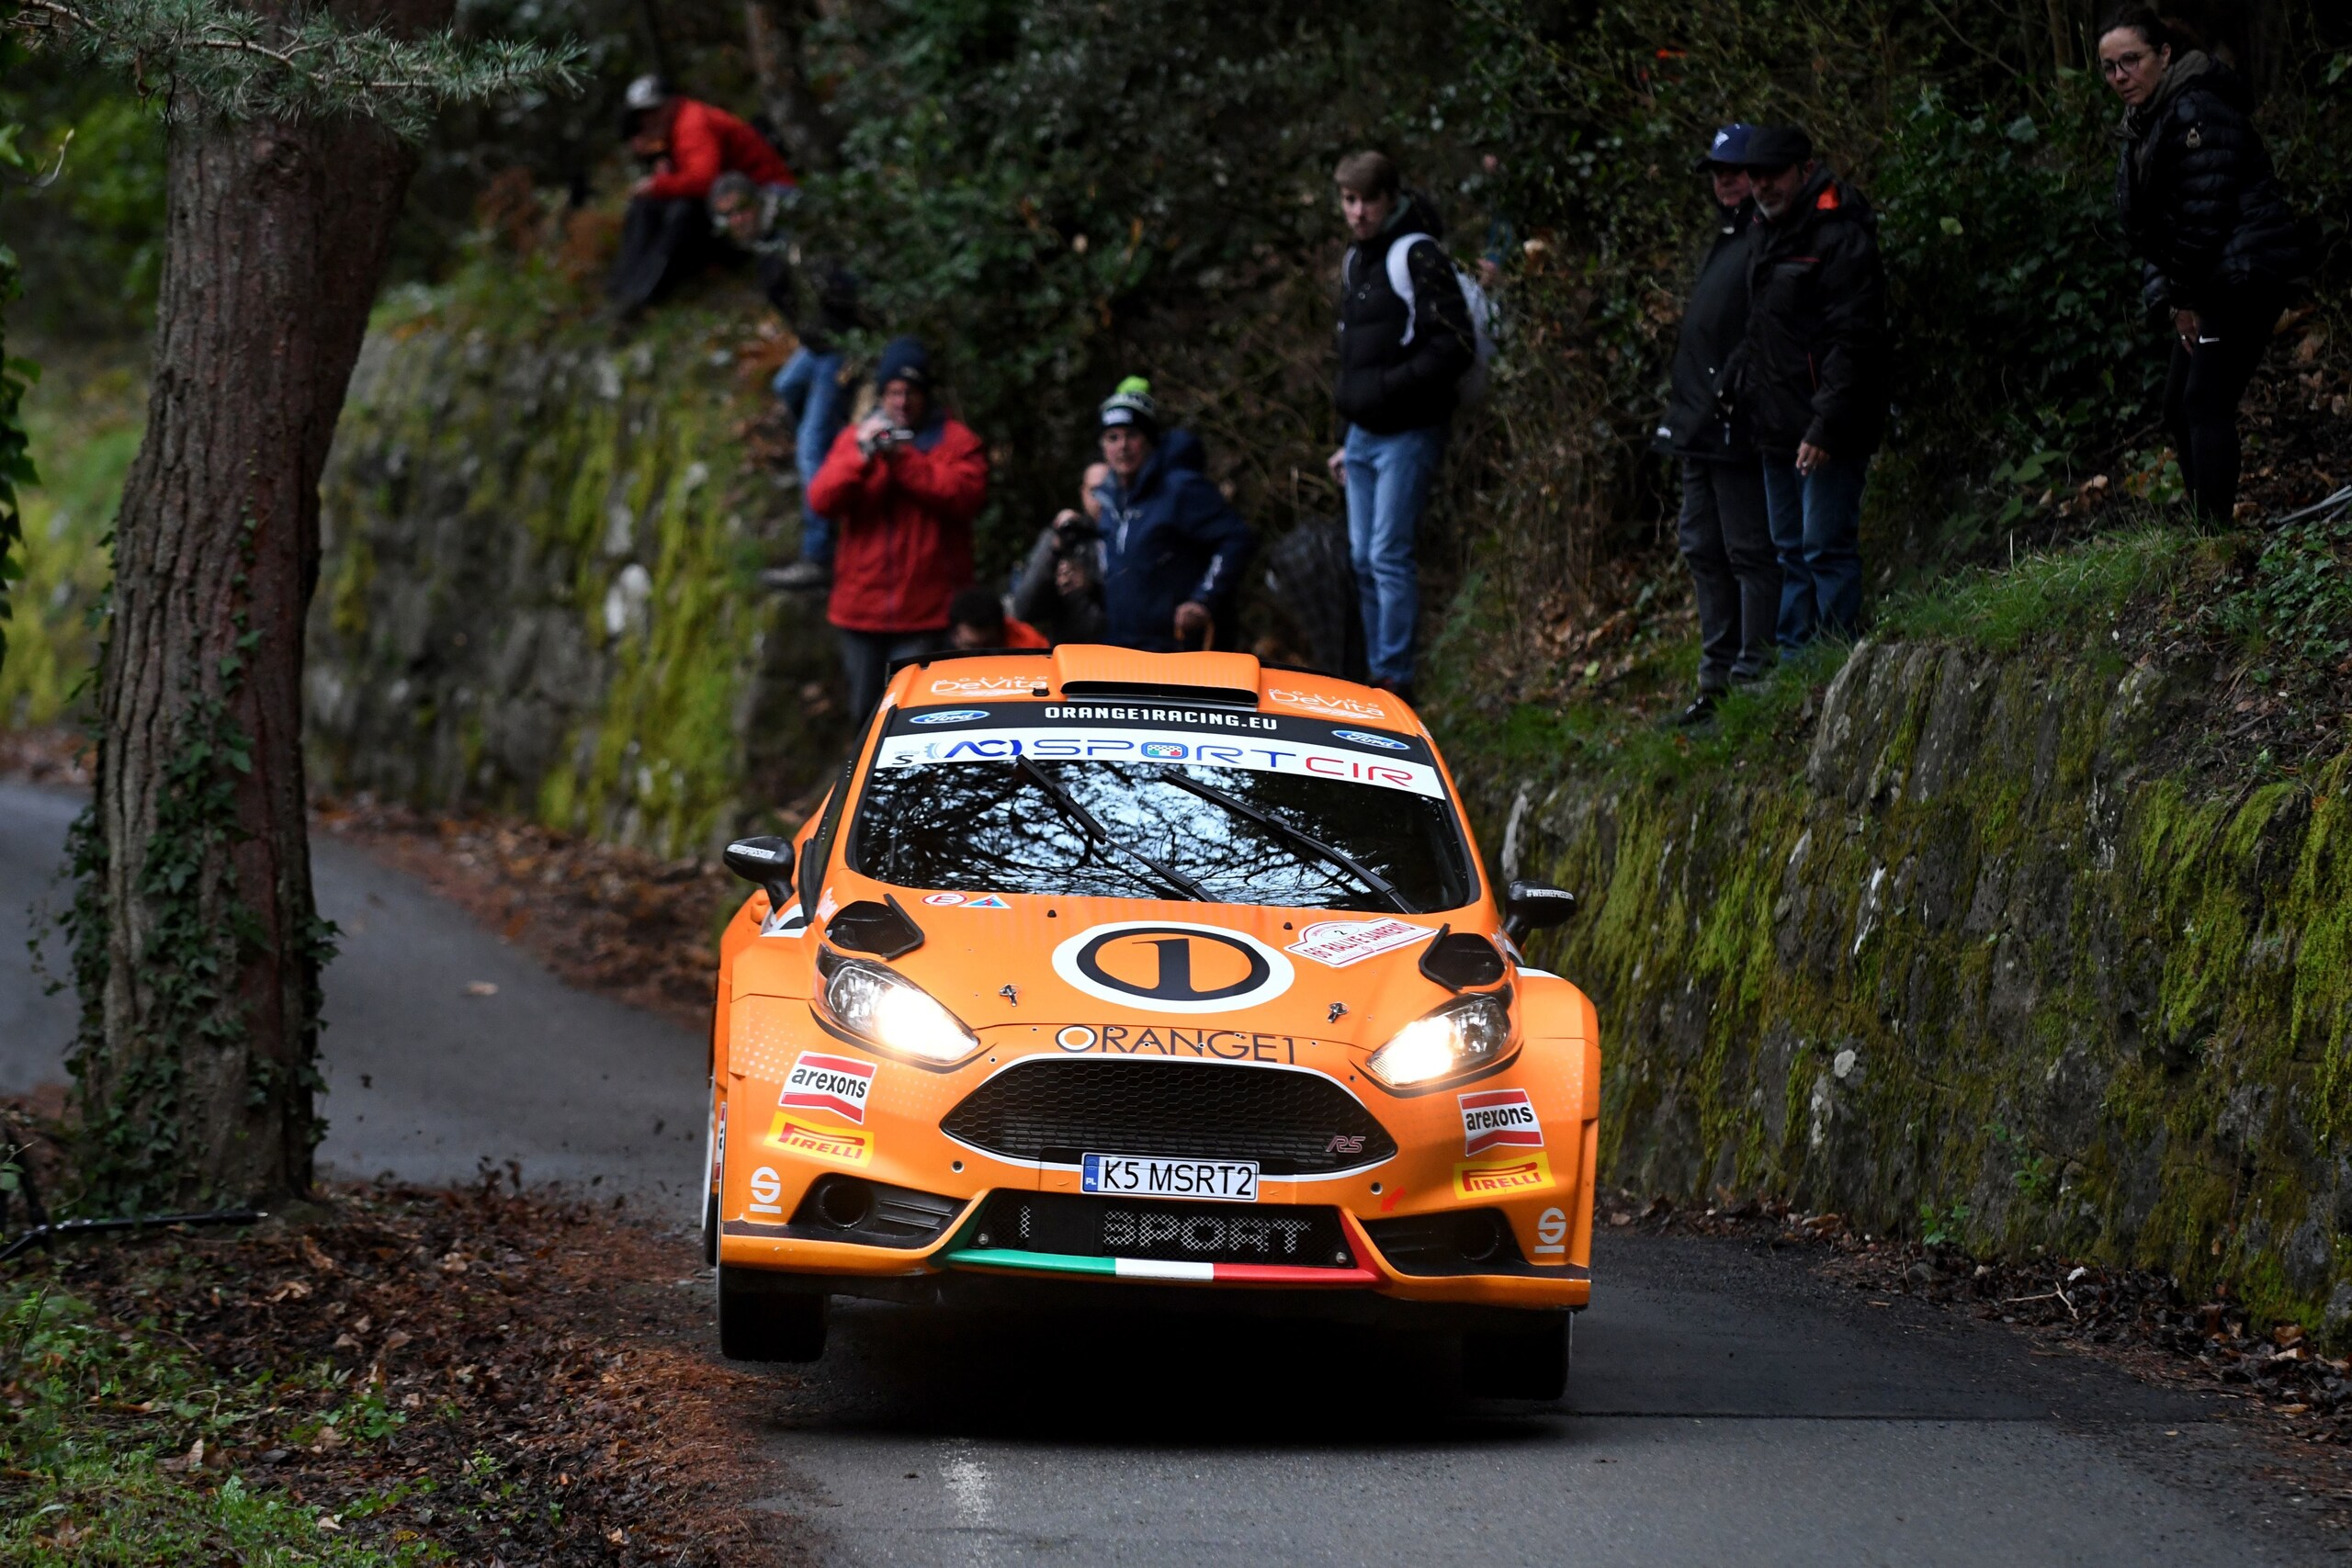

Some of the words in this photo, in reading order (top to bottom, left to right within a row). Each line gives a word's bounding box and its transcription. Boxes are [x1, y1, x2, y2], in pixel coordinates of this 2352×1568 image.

[931, 678, 1047, 693] DeVita
[1045, 706, 1278, 731] ORANGE1RACING.EU
[1270, 692, 1385, 716] DeVita
[1034, 739, 1296, 768] SPORT
[1306, 756, 1413, 787] CIR
[1320, 935, 1371, 953] RALLYE
[1357, 922, 1417, 942] SANREMO
[1055, 1024, 1295, 1066] ORANGE1
[791, 1067, 867, 1099] arexons
[1465, 1106, 1533, 1131] arexons
[778, 1122, 865, 1159] PIRELLI
[1325, 1135, 1366, 1154] RS
[1085, 1177, 1097, 1186] PL
[1104, 1159, 1139, 1190] K5
[1148, 1162, 1252, 1196] MSRT2
[1463, 1161, 1543, 1192] PIRELLI
